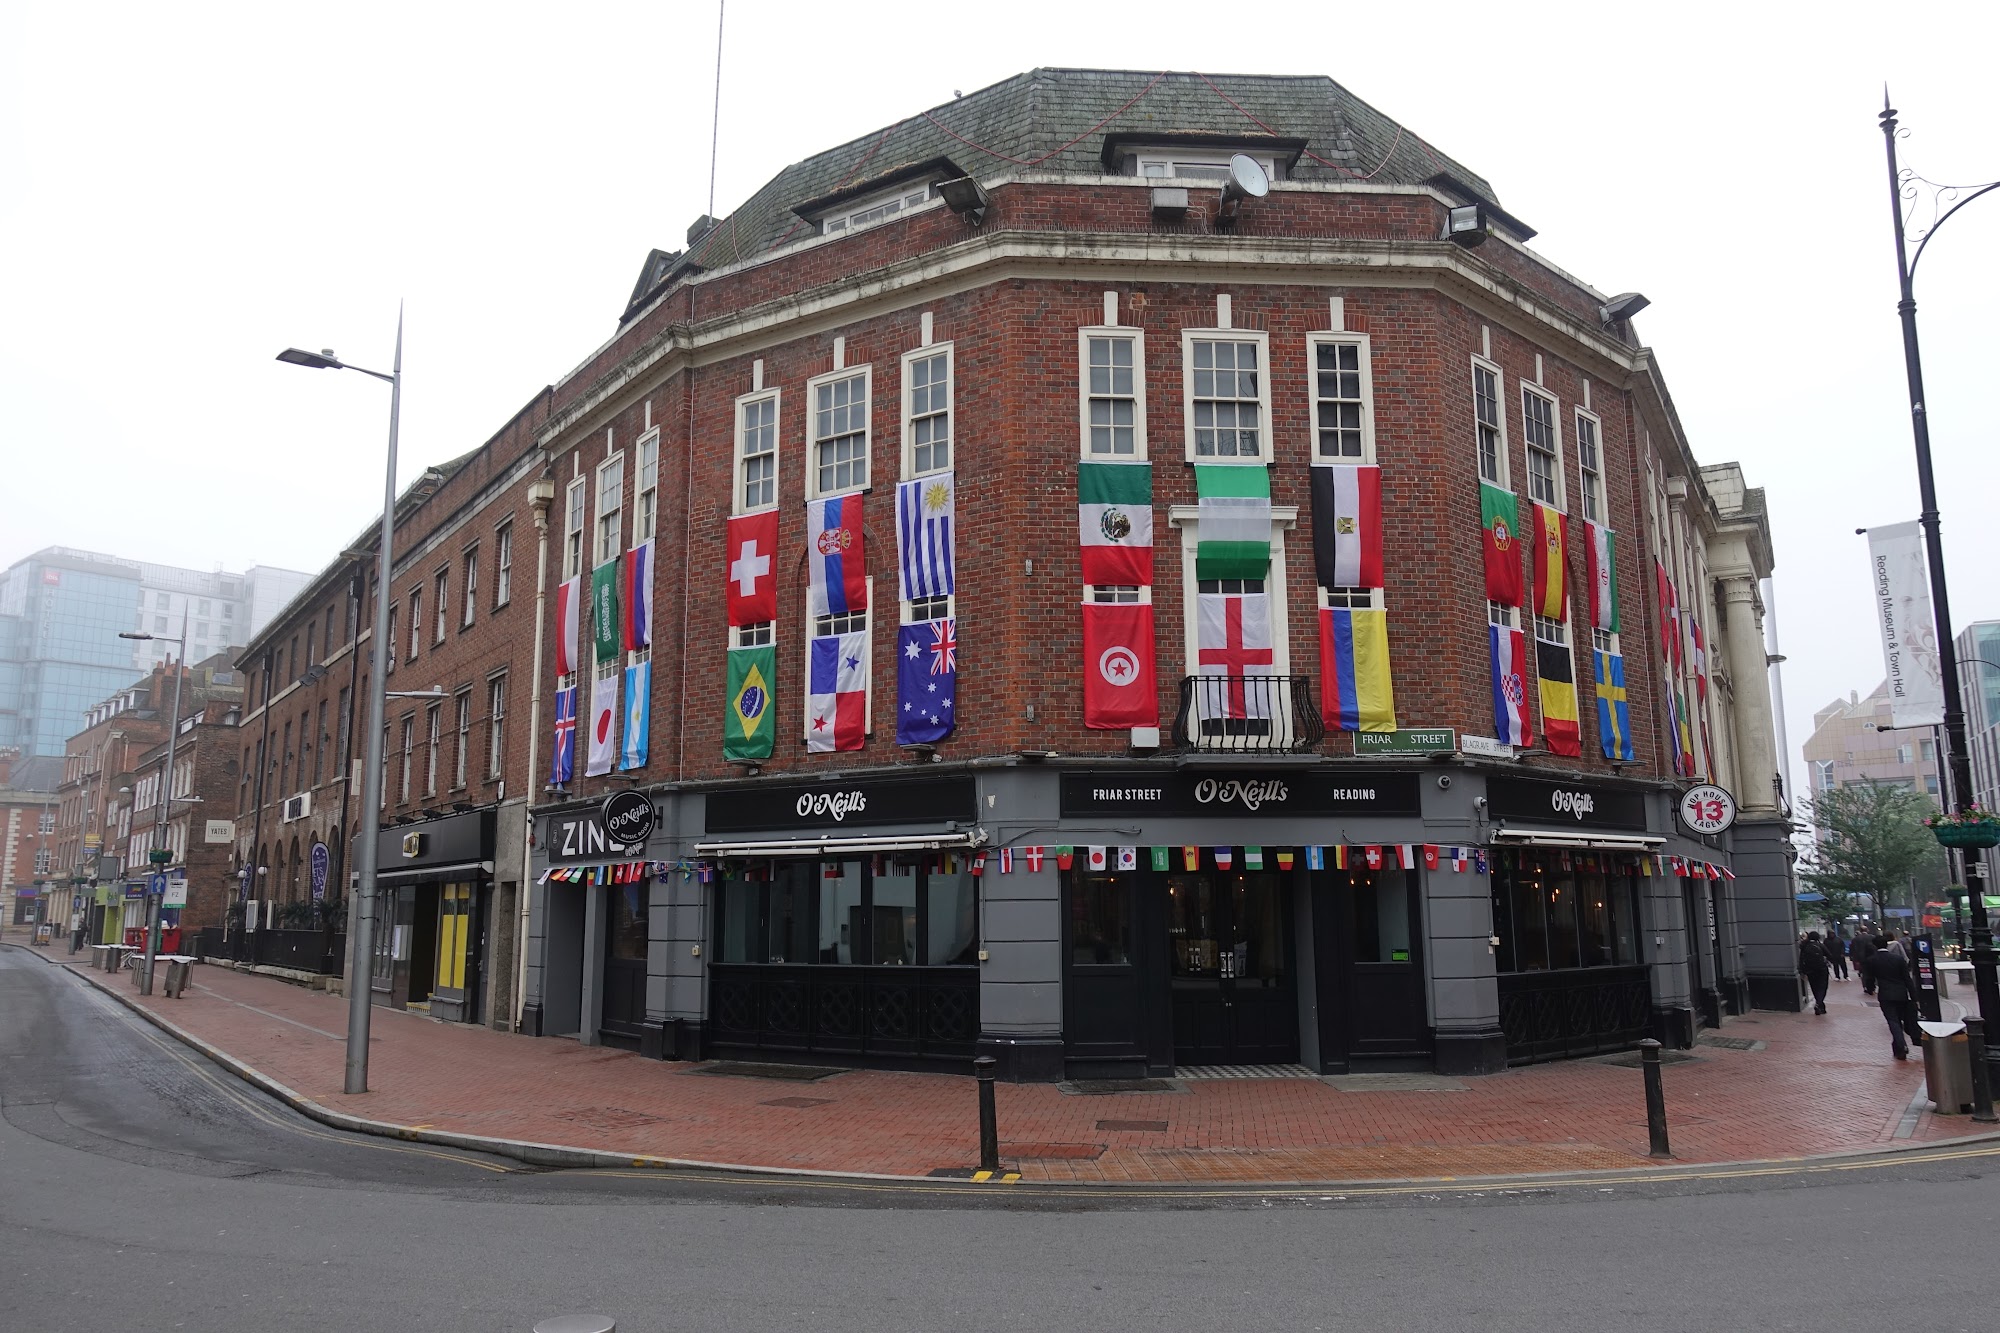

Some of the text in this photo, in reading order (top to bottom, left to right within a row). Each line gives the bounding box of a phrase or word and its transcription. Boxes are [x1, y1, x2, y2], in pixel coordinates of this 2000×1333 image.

[1876, 555, 1906, 698] Reading Museum & Town Hall
[1362, 734, 1447, 744] FRIAR STREET
[1462, 740, 1512, 754] BLAGRAVE STREET
[1093, 789, 1162, 800] FRIAR STREET
[1194, 778, 1289, 811] O'Neill's
[1333, 788, 1376, 800] READING
[1687, 790, 1728, 809] HOP HOUSE
[796, 790, 867, 821] O'Neill's
[1551, 789, 1594, 820] O'Neill's
[1692, 800, 1724, 821] 13
[609, 803, 650, 830] O'Neill's
[1694, 818, 1723, 828] LAGER
[621, 822, 650, 840] MUSIC ROOM
